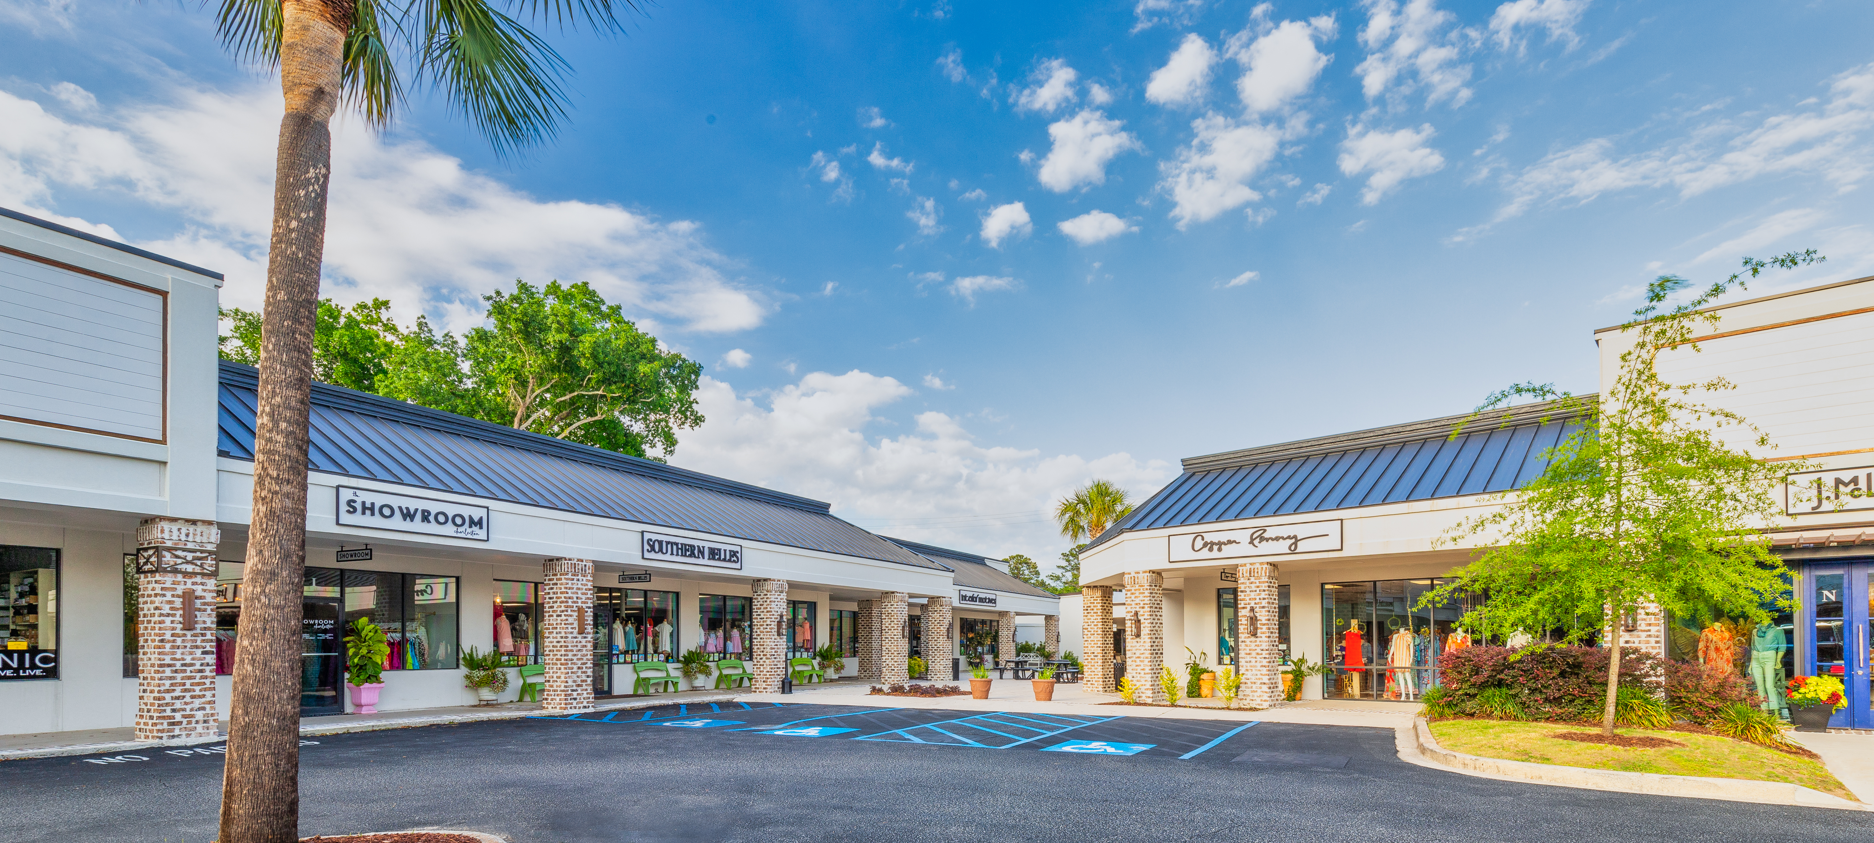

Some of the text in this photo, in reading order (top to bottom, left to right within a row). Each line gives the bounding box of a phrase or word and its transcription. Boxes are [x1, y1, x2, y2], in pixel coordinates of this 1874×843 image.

[346, 499, 483, 529] SHOWROOM
[646, 538, 740, 564] SOUTHERN BELLES
[1191, 528, 1329, 553] Copper Penny
[1822, 590, 1837, 601] N
[83, 754, 150, 765] NO
